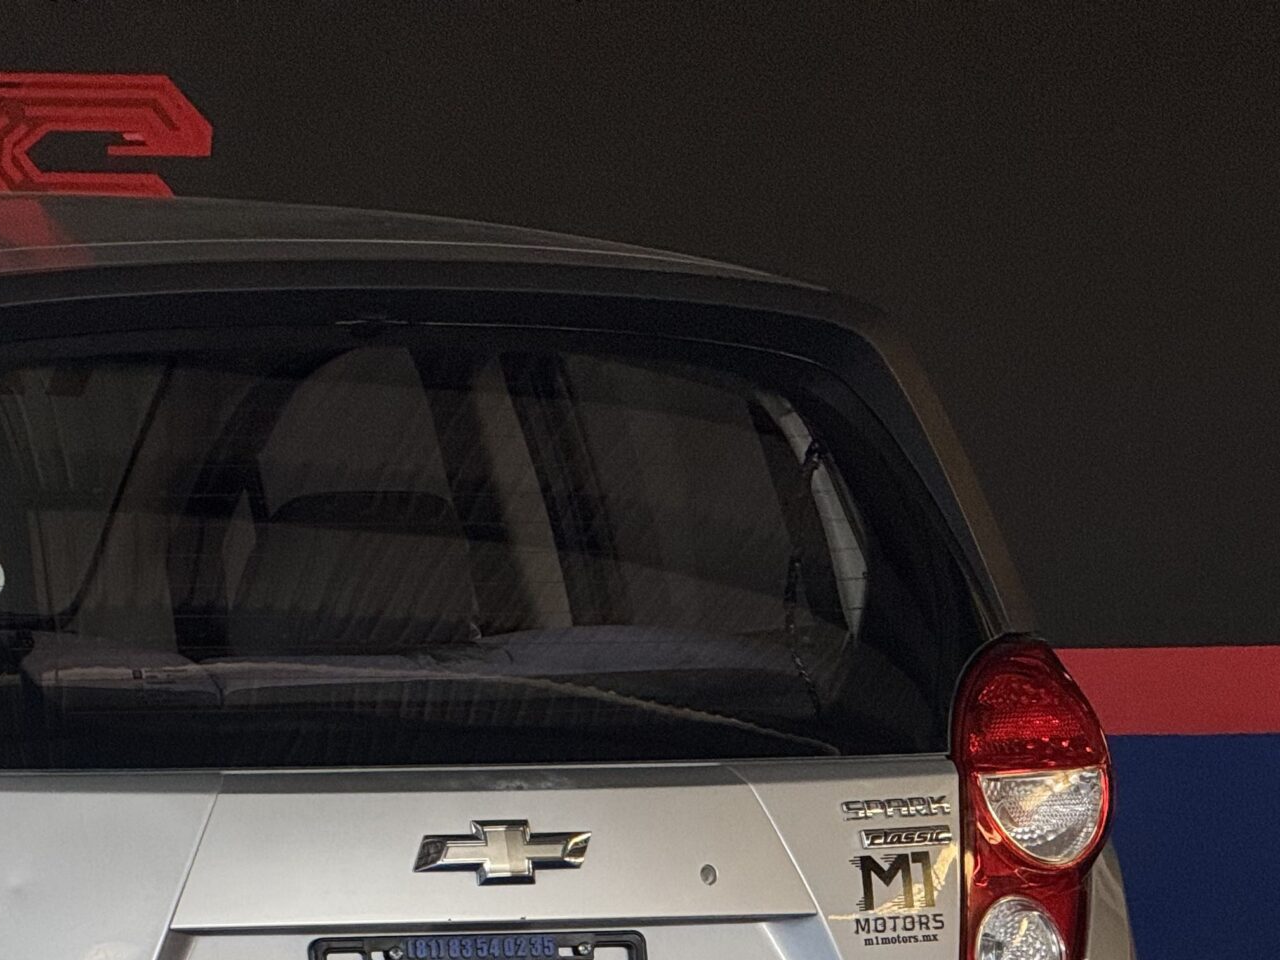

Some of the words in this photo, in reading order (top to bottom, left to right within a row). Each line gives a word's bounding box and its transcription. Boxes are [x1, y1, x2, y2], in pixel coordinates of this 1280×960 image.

[841, 795, 952, 822] SPARK
[849, 851, 936, 912] M1
[854, 913, 945, 935] MOTORS
[864, 933, 939, 946] m1motors.mx
